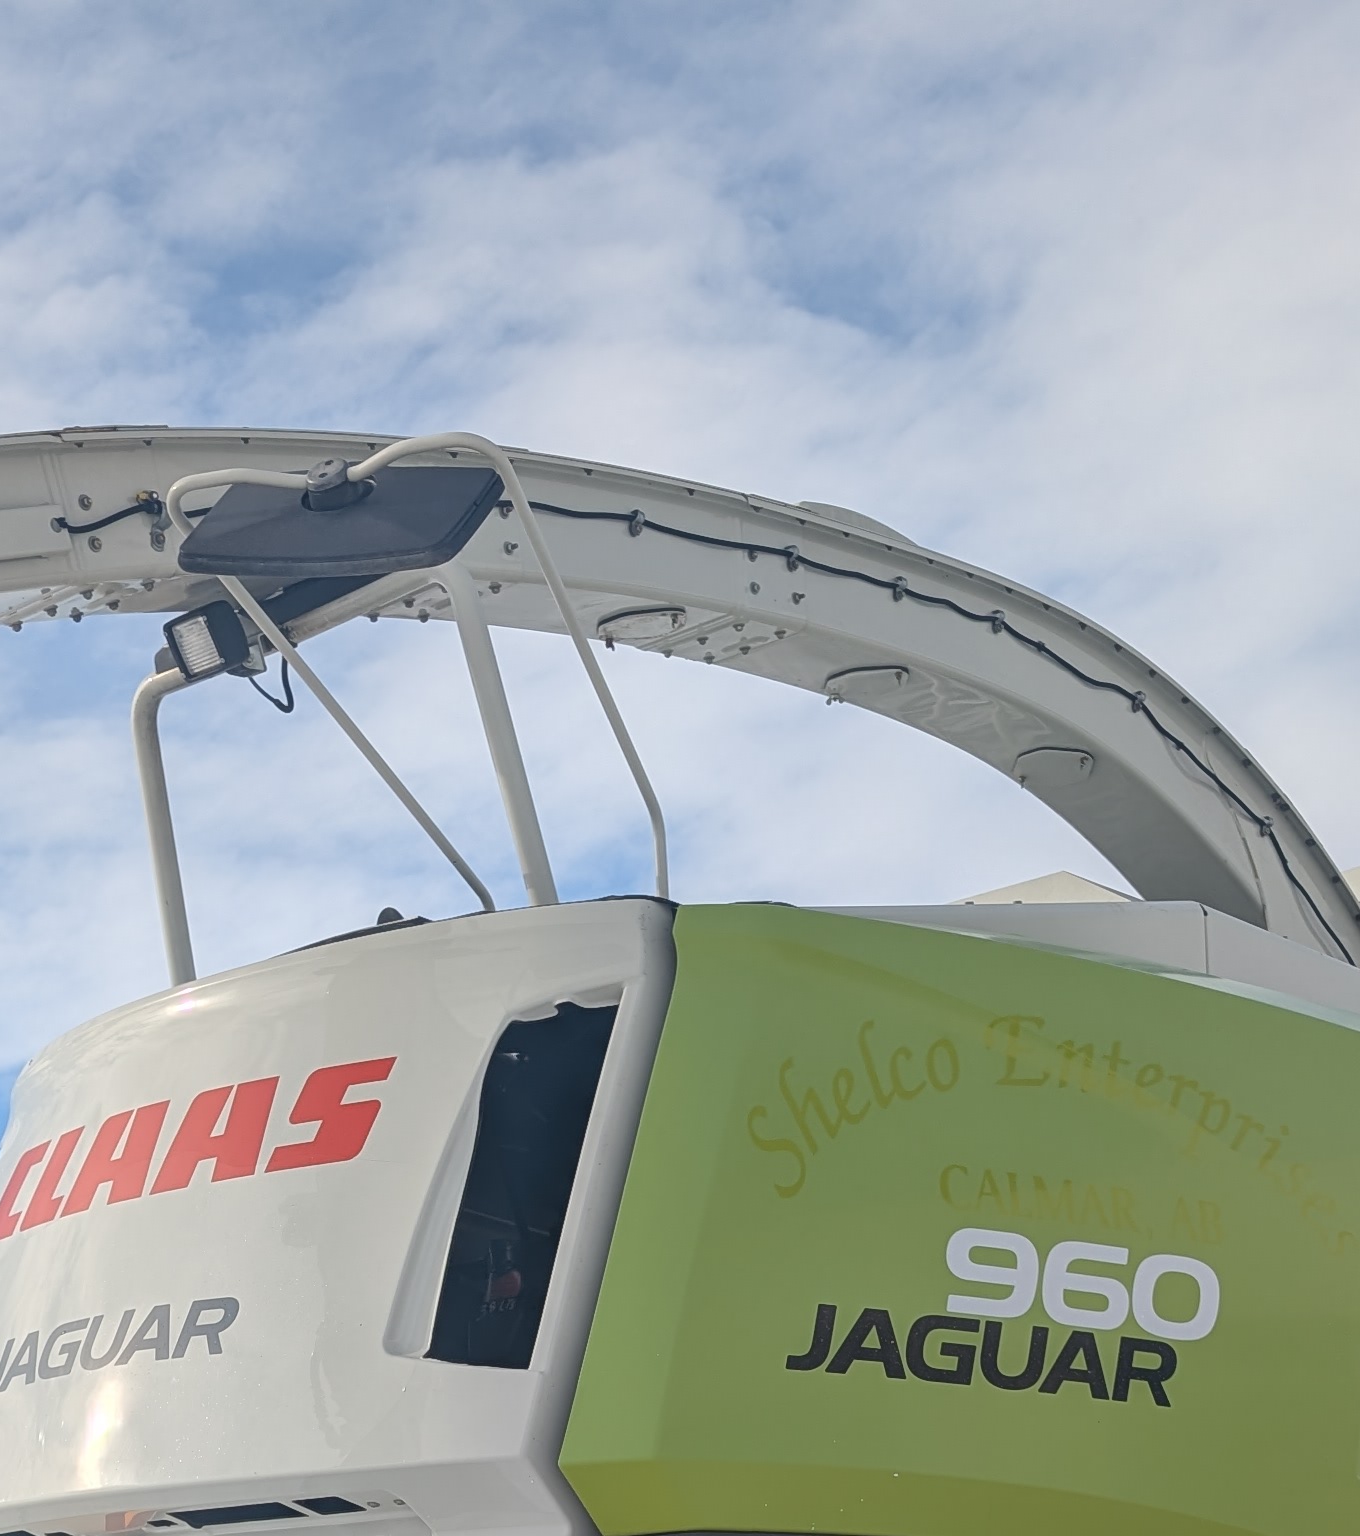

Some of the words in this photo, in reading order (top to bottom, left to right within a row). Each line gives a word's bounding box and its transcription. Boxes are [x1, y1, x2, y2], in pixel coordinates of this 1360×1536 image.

[746, 1019, 961, 1199] Shelco
[1169, 1193, 1227, 1247] AB
[945, 1227, 1221, 1342] 960
[784, 1303, 1179, 1408] JAGUAR
